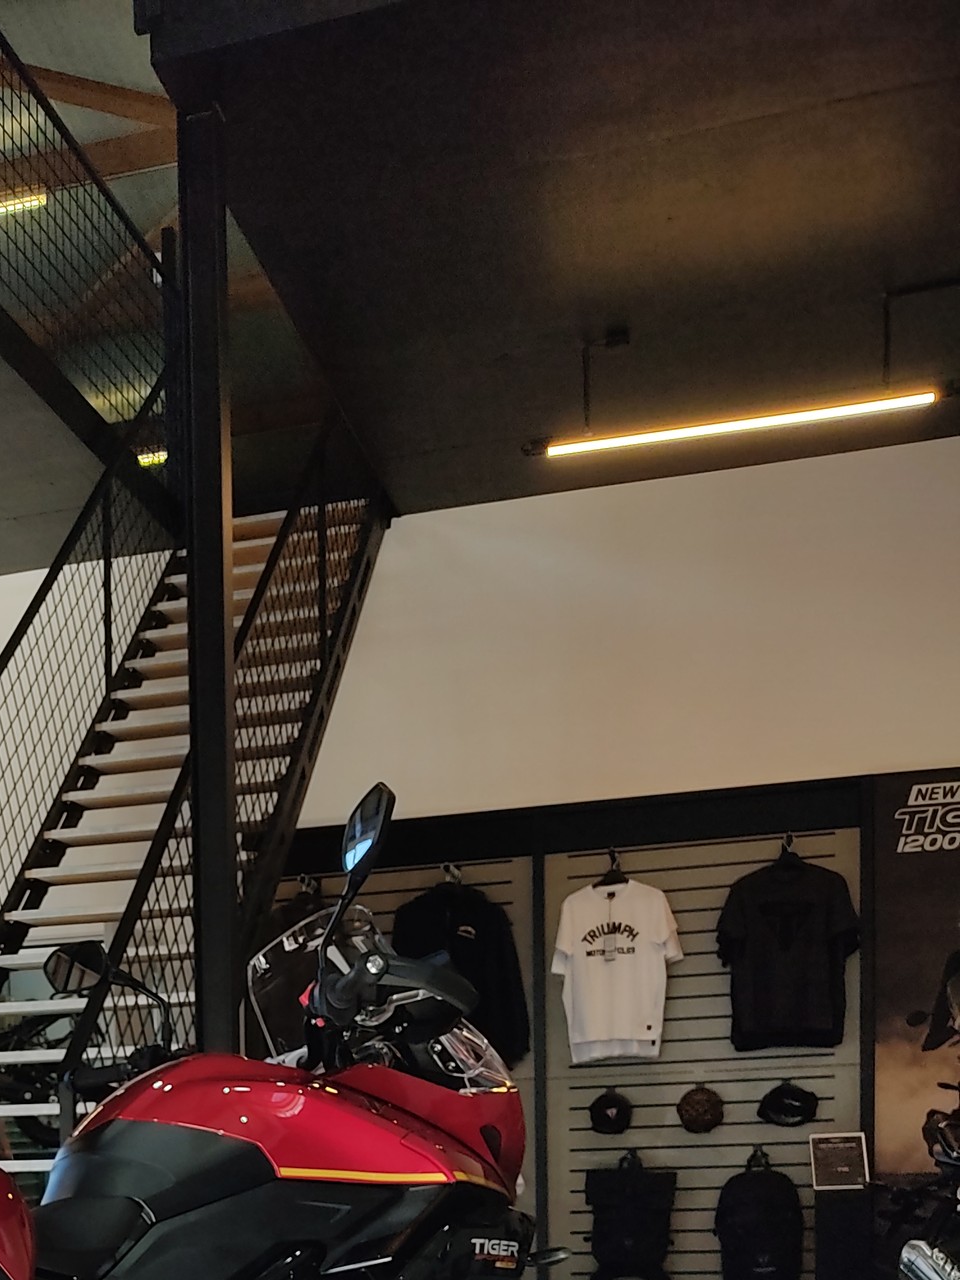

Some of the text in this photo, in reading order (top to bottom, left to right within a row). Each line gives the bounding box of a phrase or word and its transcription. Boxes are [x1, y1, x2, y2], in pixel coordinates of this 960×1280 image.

[914, 785, 960, 802] NEW
[896, 832, 960, 853] 1200
[581, 921, 639, 945] TRIUMPH
[470, 1238, 519, 1257] TIGER
